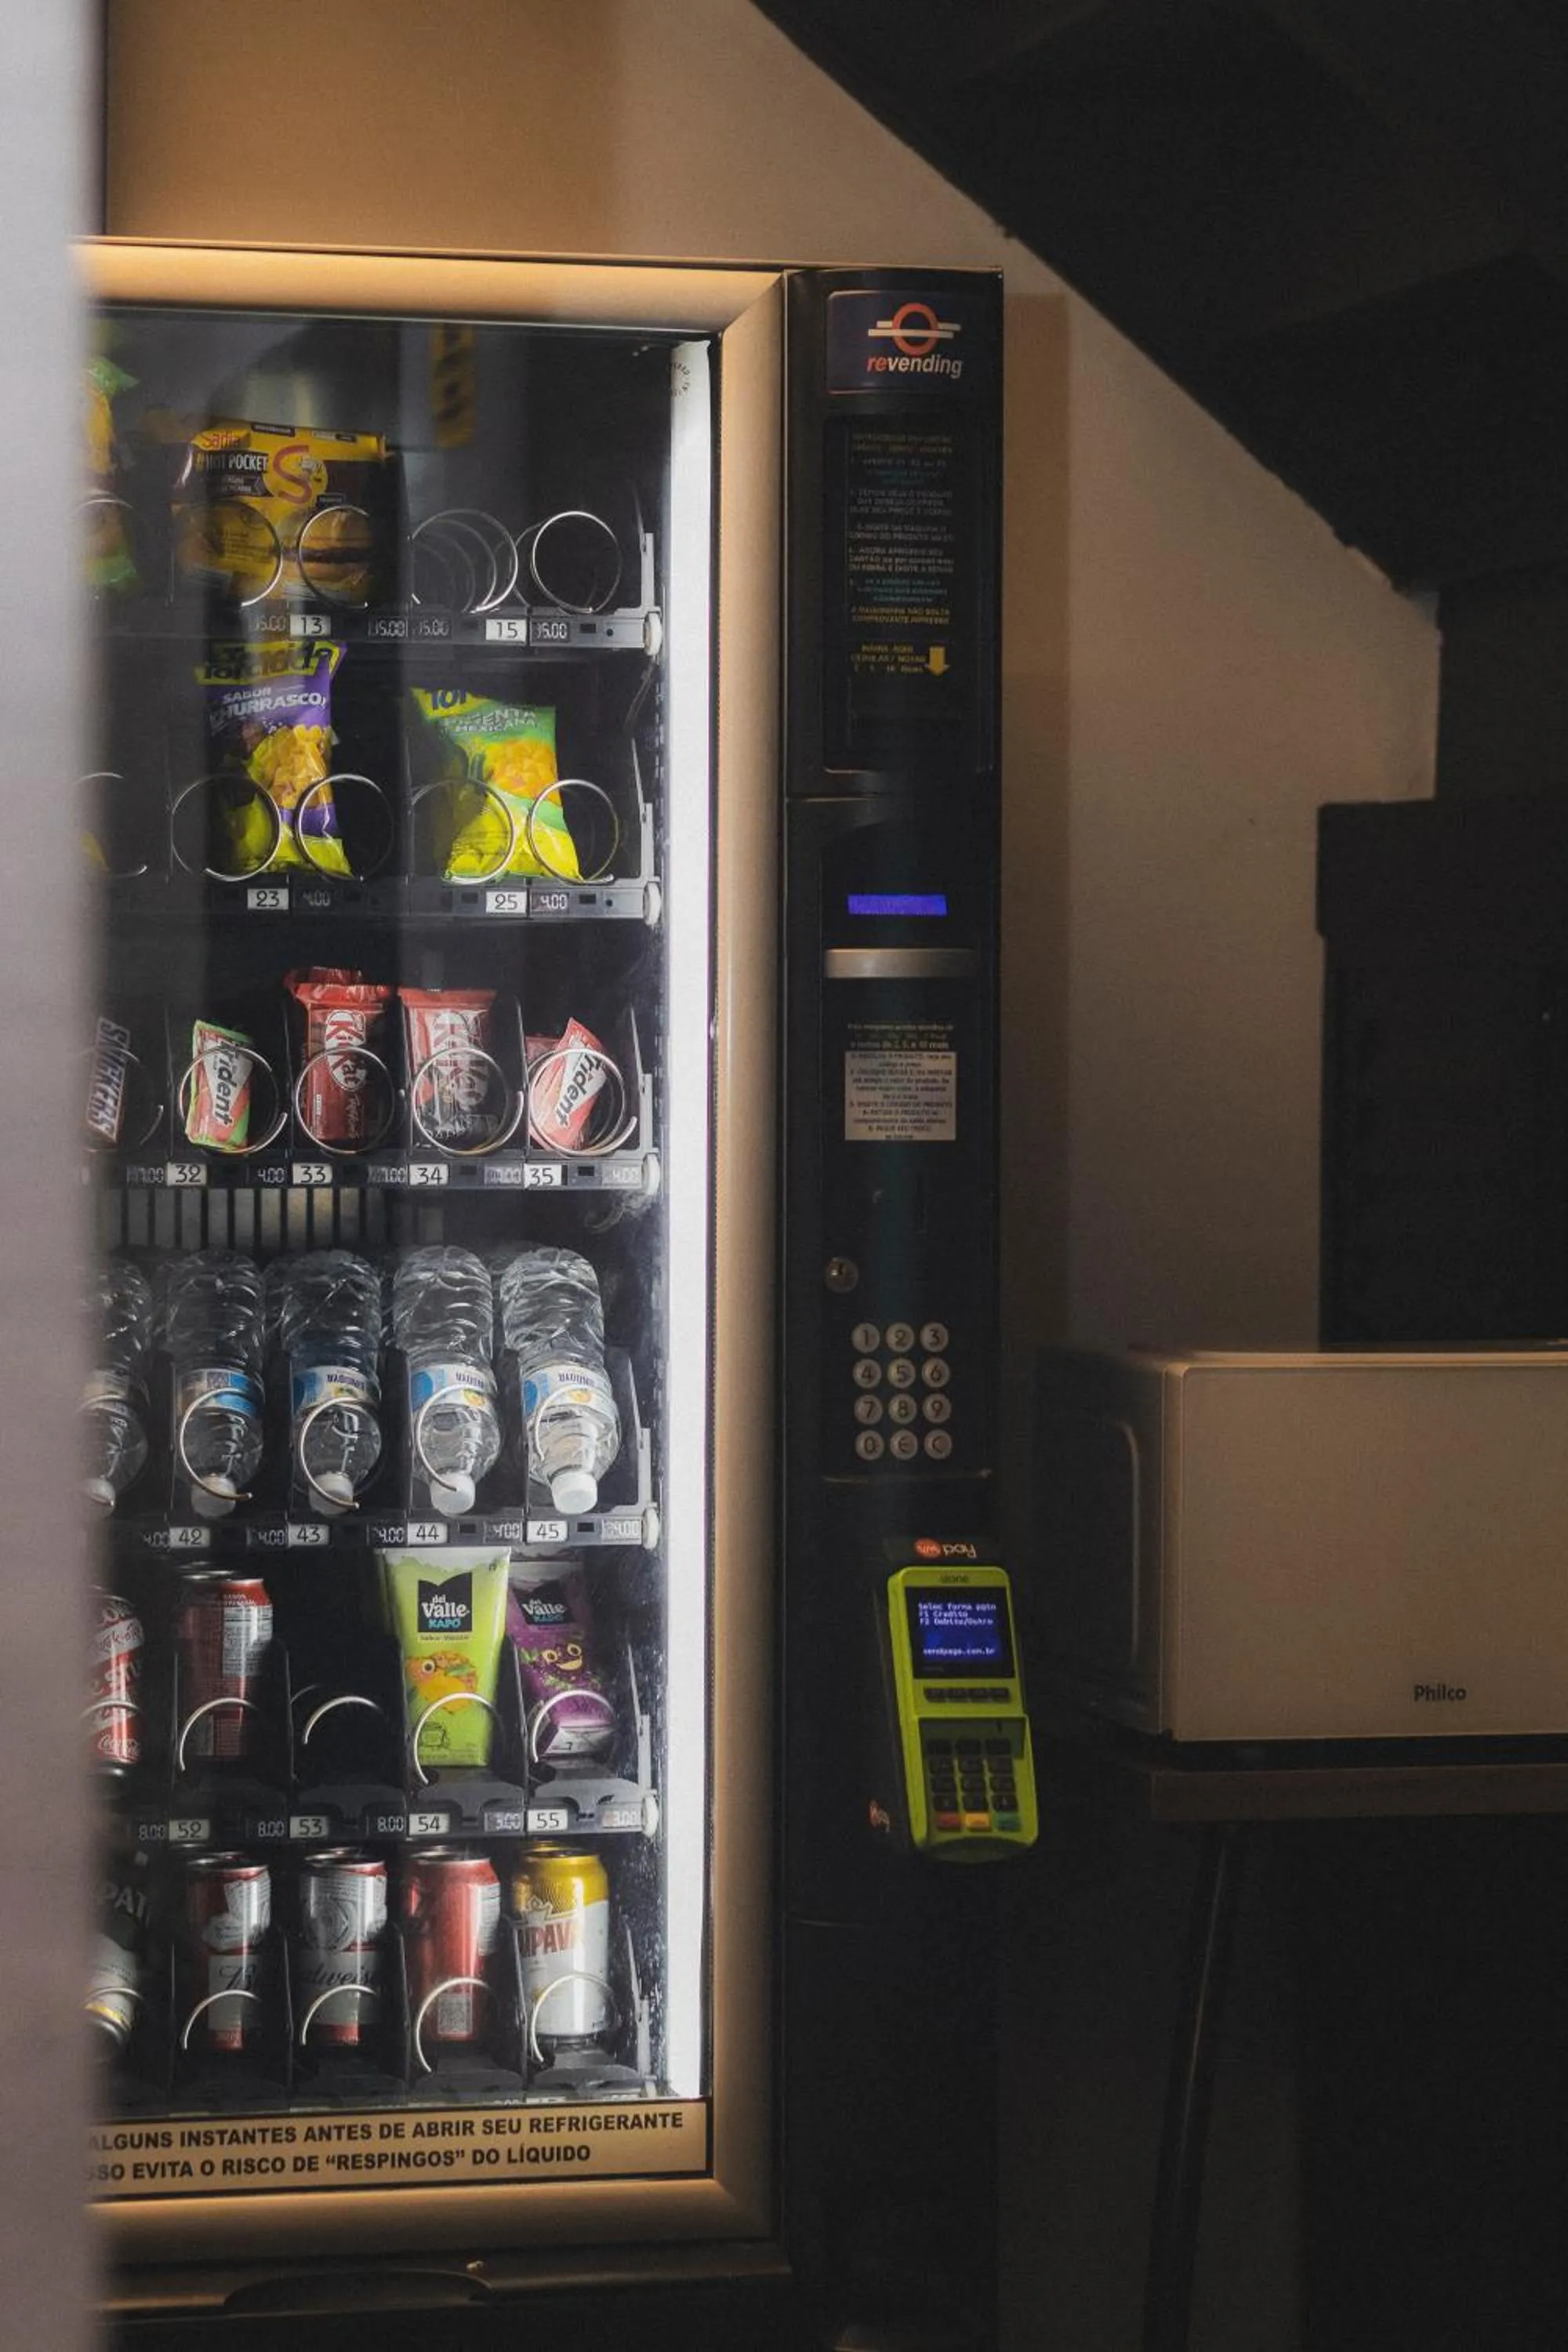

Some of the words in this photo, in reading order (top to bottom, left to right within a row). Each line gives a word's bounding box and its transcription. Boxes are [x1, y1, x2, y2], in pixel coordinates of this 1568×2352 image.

[866, 354, 962, 379] revending
[228, 452, 268, 472] POCKET
[300, 616, 324, 634] 13
[496, 621, 518, 638] 15
[256, 890, 280, 907] 23
[495, 893, 518, 910] 25
[540, 894, 568, 910] 4.00
[176, 1164, 201, 1183] 32
[300, 1165, 325, 1183] 33
[417, 1167, 443, 1185] 34
[529, 1167, 554, 1185] 35
[895, 1330, 906, 1347] 2
[930, 1329, 940, 1345] 3
[862, 1366, 873, 1383] 4
[896, 1365, 907, 1382] 5
[931, 1365, 942, 1381] 6
[864, 1400, 874, 1420] 7
[898, 1400, 908, 1417] 8
[931, 1400, 943, 1418] 9
[864, 1436, 876, 1454] 0
[180, 1528, 201, 1545] 42
[297, 1526, 321, 1543] 43
[378, 1526, 404, 1543] 4.00
[416, 1524, 440, 1541] 44
[536, 1523, 559, 1539] 45
[433, 1594, 446, 1603] del
[421, 1601, 467, 1618] Valle
[521, 1602, 566, 1616] Valle
[428, 1617, 462, 1630] KAPO
[1414, 1683, 1467, 1702] Philco
[178, 1820, 201, 1838] 52
[258, 1820, 285, 1838] 8.00
[299, 1818, 322, 1835] 53
[377, 1816, 405, 1832] 8.00
[418, 1815, 441, 1832] 54
[537, 1812, 560, 1829] 55
[180, 2126, 297, 2148] INSTANTES
[303, 2122, 372, 2142] ANTES
[379, 2122, 405, 2140] DE
[412, 2119, 475, 2139] ABRIR
[481, 2118, 522, 2136] SEU
[529, 2112, 684, 2134] REFRIGERANTE
[132, 2160, 194, 2180] EVITA
[200, 2158, 216, 2176] O
[222, 2156, 286, 2176] RISCO
[292, 2155, 320, 2172] DE
[472, 2147, 500, 2165] DO
[507, 2143, 591, 2164] LÍQUIDO
